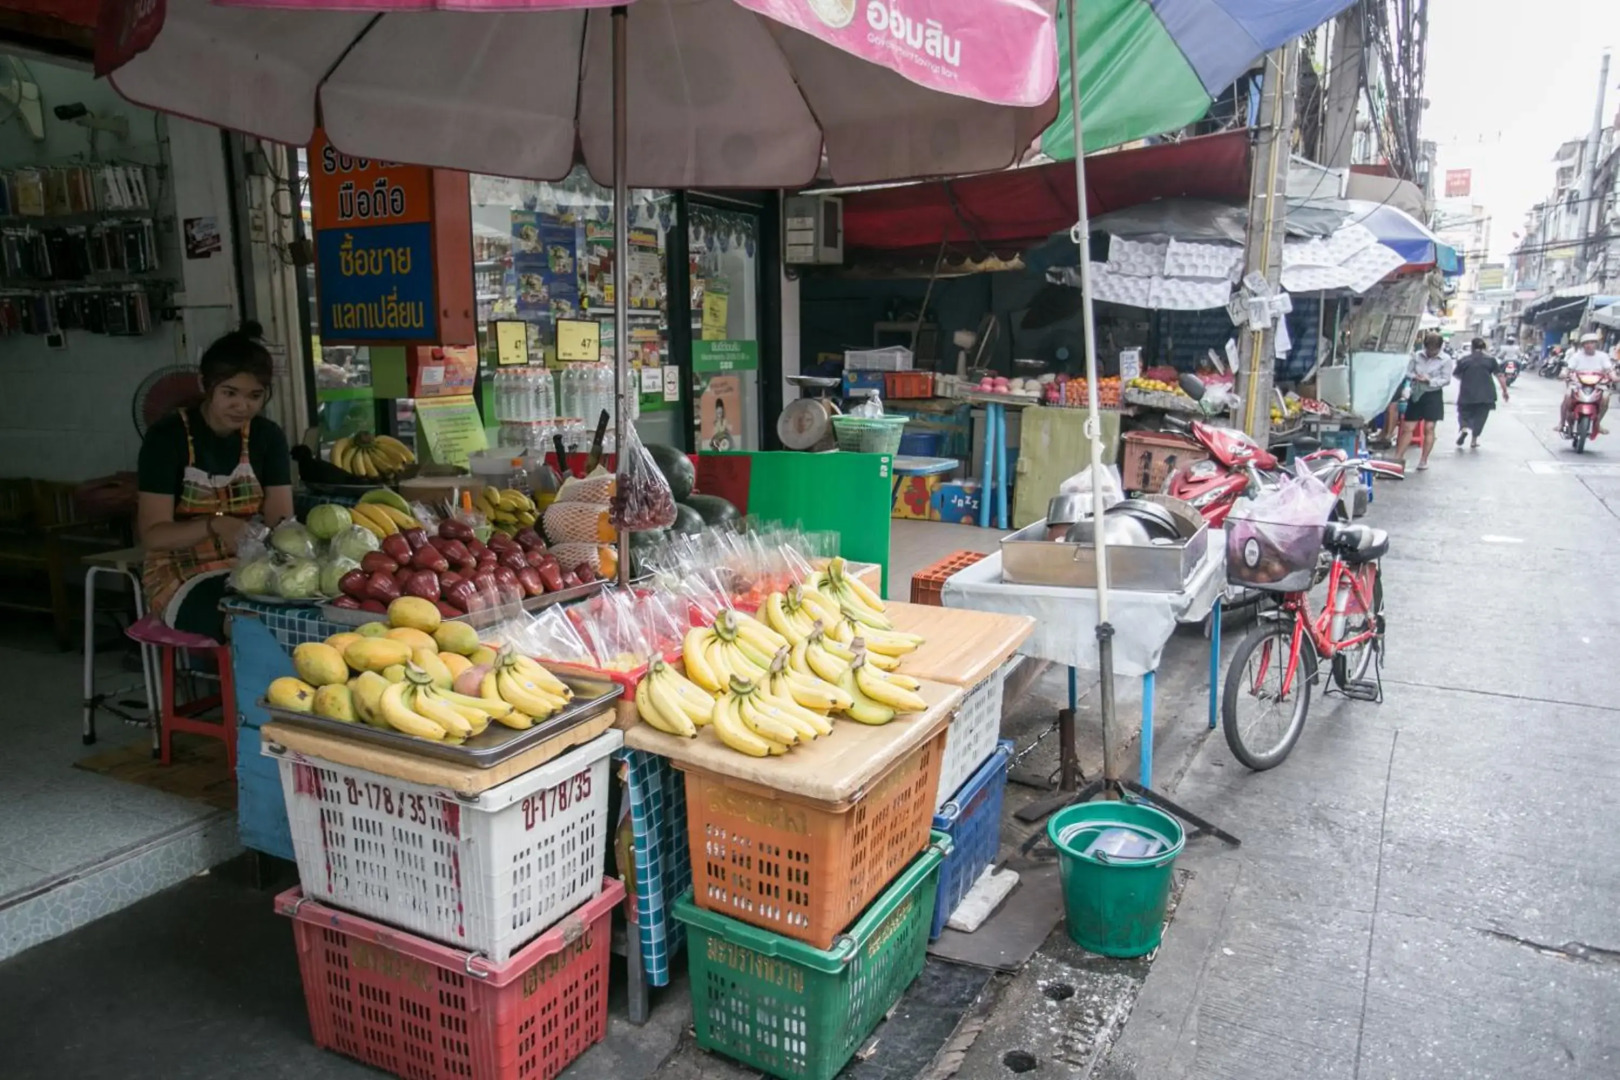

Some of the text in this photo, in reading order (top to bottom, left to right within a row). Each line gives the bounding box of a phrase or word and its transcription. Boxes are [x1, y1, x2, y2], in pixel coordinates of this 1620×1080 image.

[867, 0, 961, 67] ออมสิน
[339, 178, 405, 220] มือถือ
[339, 233, 412, 276] ซื้อขาย
[332, 285, 424, 329] แลกเปลี่ยน
[951, 494, 979, 510] JAZZ
